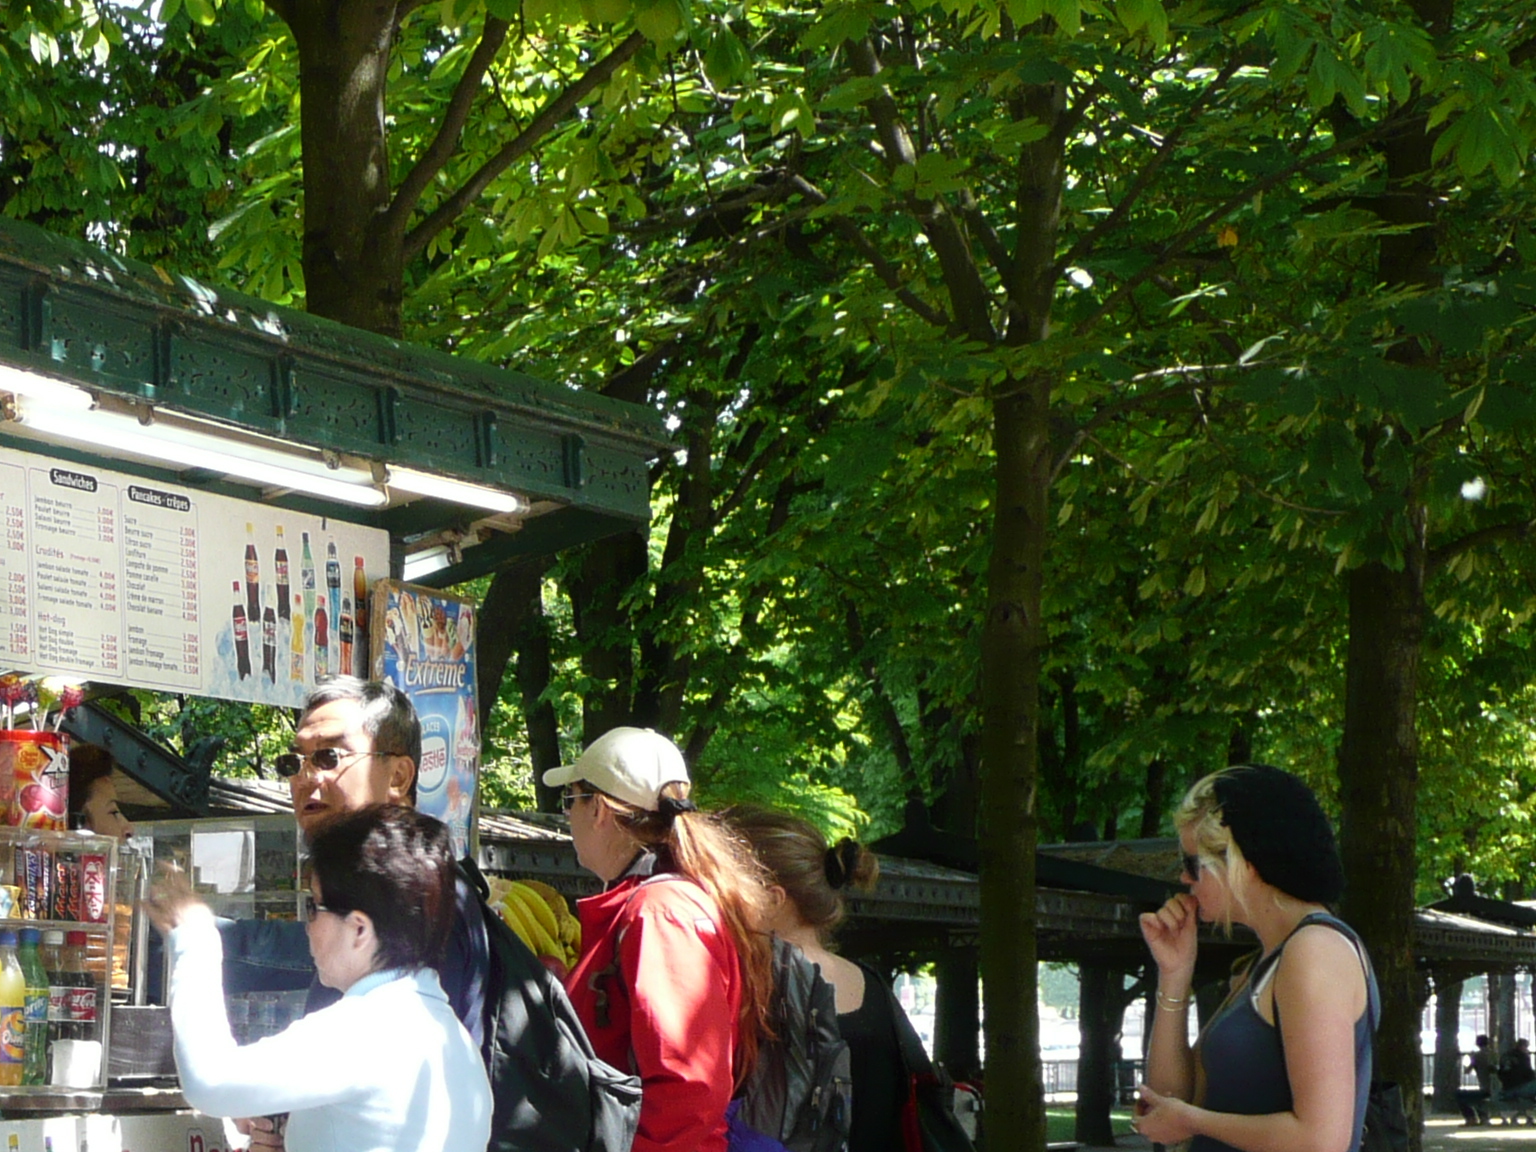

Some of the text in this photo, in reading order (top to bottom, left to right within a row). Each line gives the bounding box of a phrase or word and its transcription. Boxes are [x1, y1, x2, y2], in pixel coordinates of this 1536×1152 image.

[53, 471, 94, 490] Sandwiches
[131, 487, 161, 505] Pancakes
[404, 653, 467, 688] Extrême
